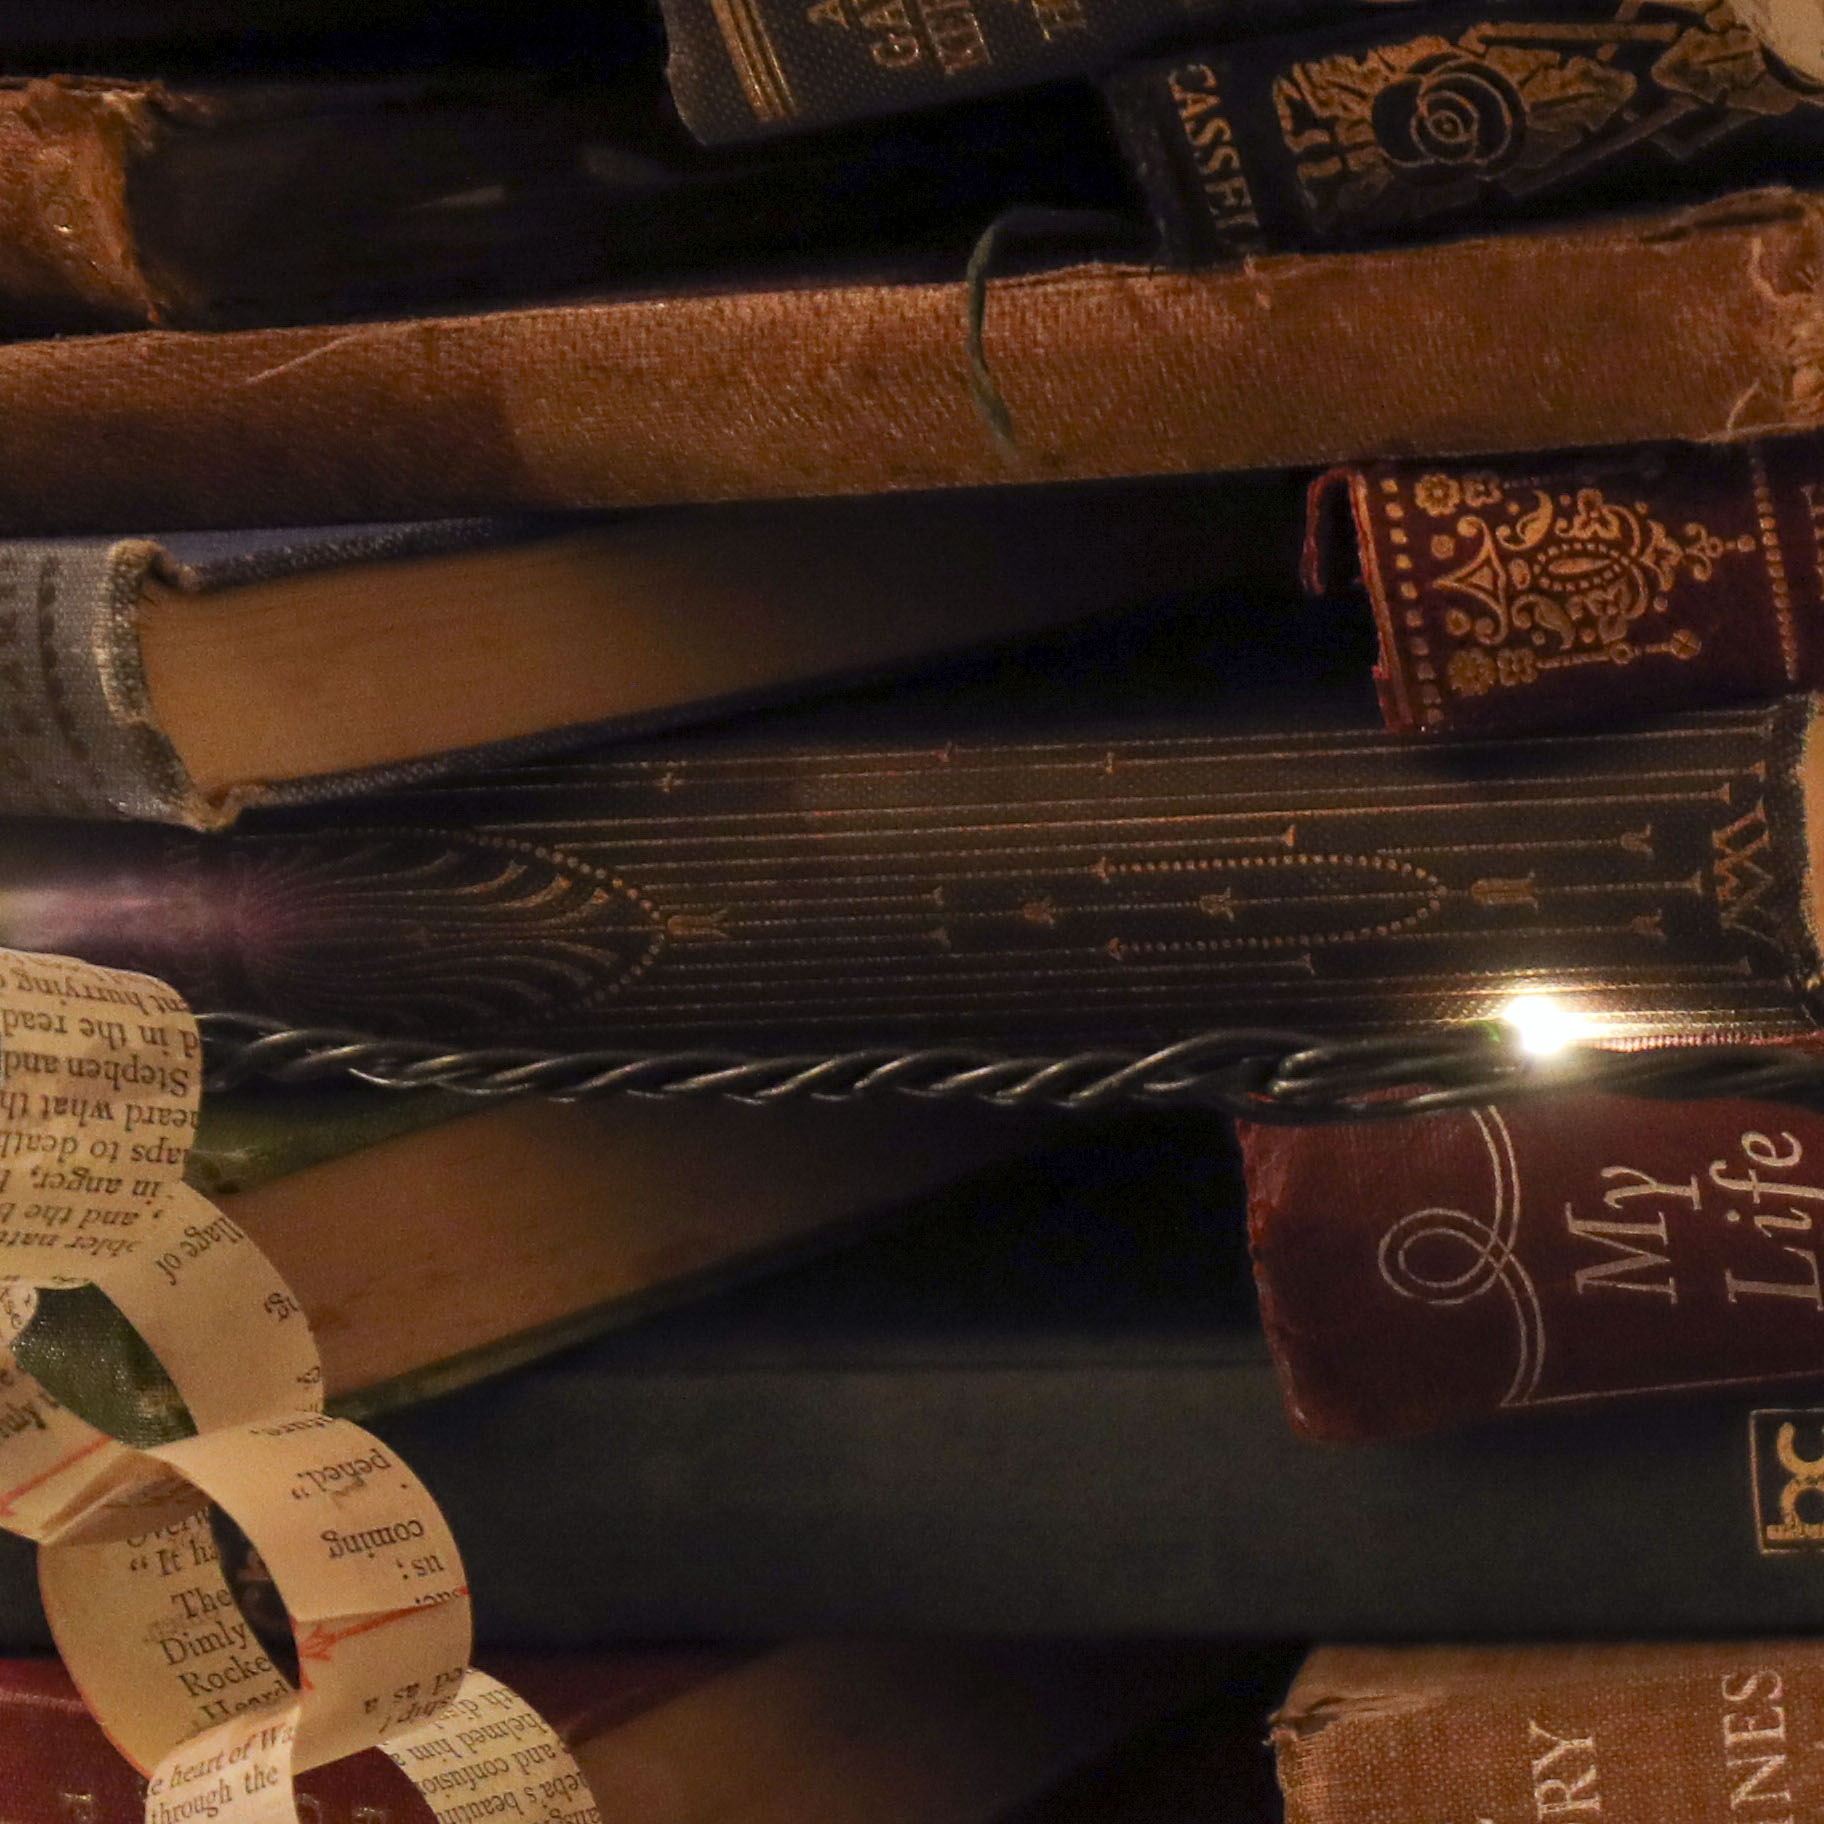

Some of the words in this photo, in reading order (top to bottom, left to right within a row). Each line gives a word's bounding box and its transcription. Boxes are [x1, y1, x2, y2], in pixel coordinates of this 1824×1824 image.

[79, 1018, 127, 1051] the
[3, 1051, 59, 1080] and
[67, 1056, 189, 1098] Stephen
[41, 1096, 114, 1127] what
[89, 1140, 119, 1164] to
[29, 1165, 124, 1196] anger,
[131, 1179, 161, 1204] in
[24, 1203, 72, 1228] the
[1564, 1166, 1701, 1305] My
[321, 1518, 424, 1561] coming
[172, 1589, 232, 1619] The
[160, 1623, 248, 1666] Dimly
[406, 1738, 455, 1763] him
[514, 1743, 557, 1776] and
[243, 1766, 279, 1792] the
